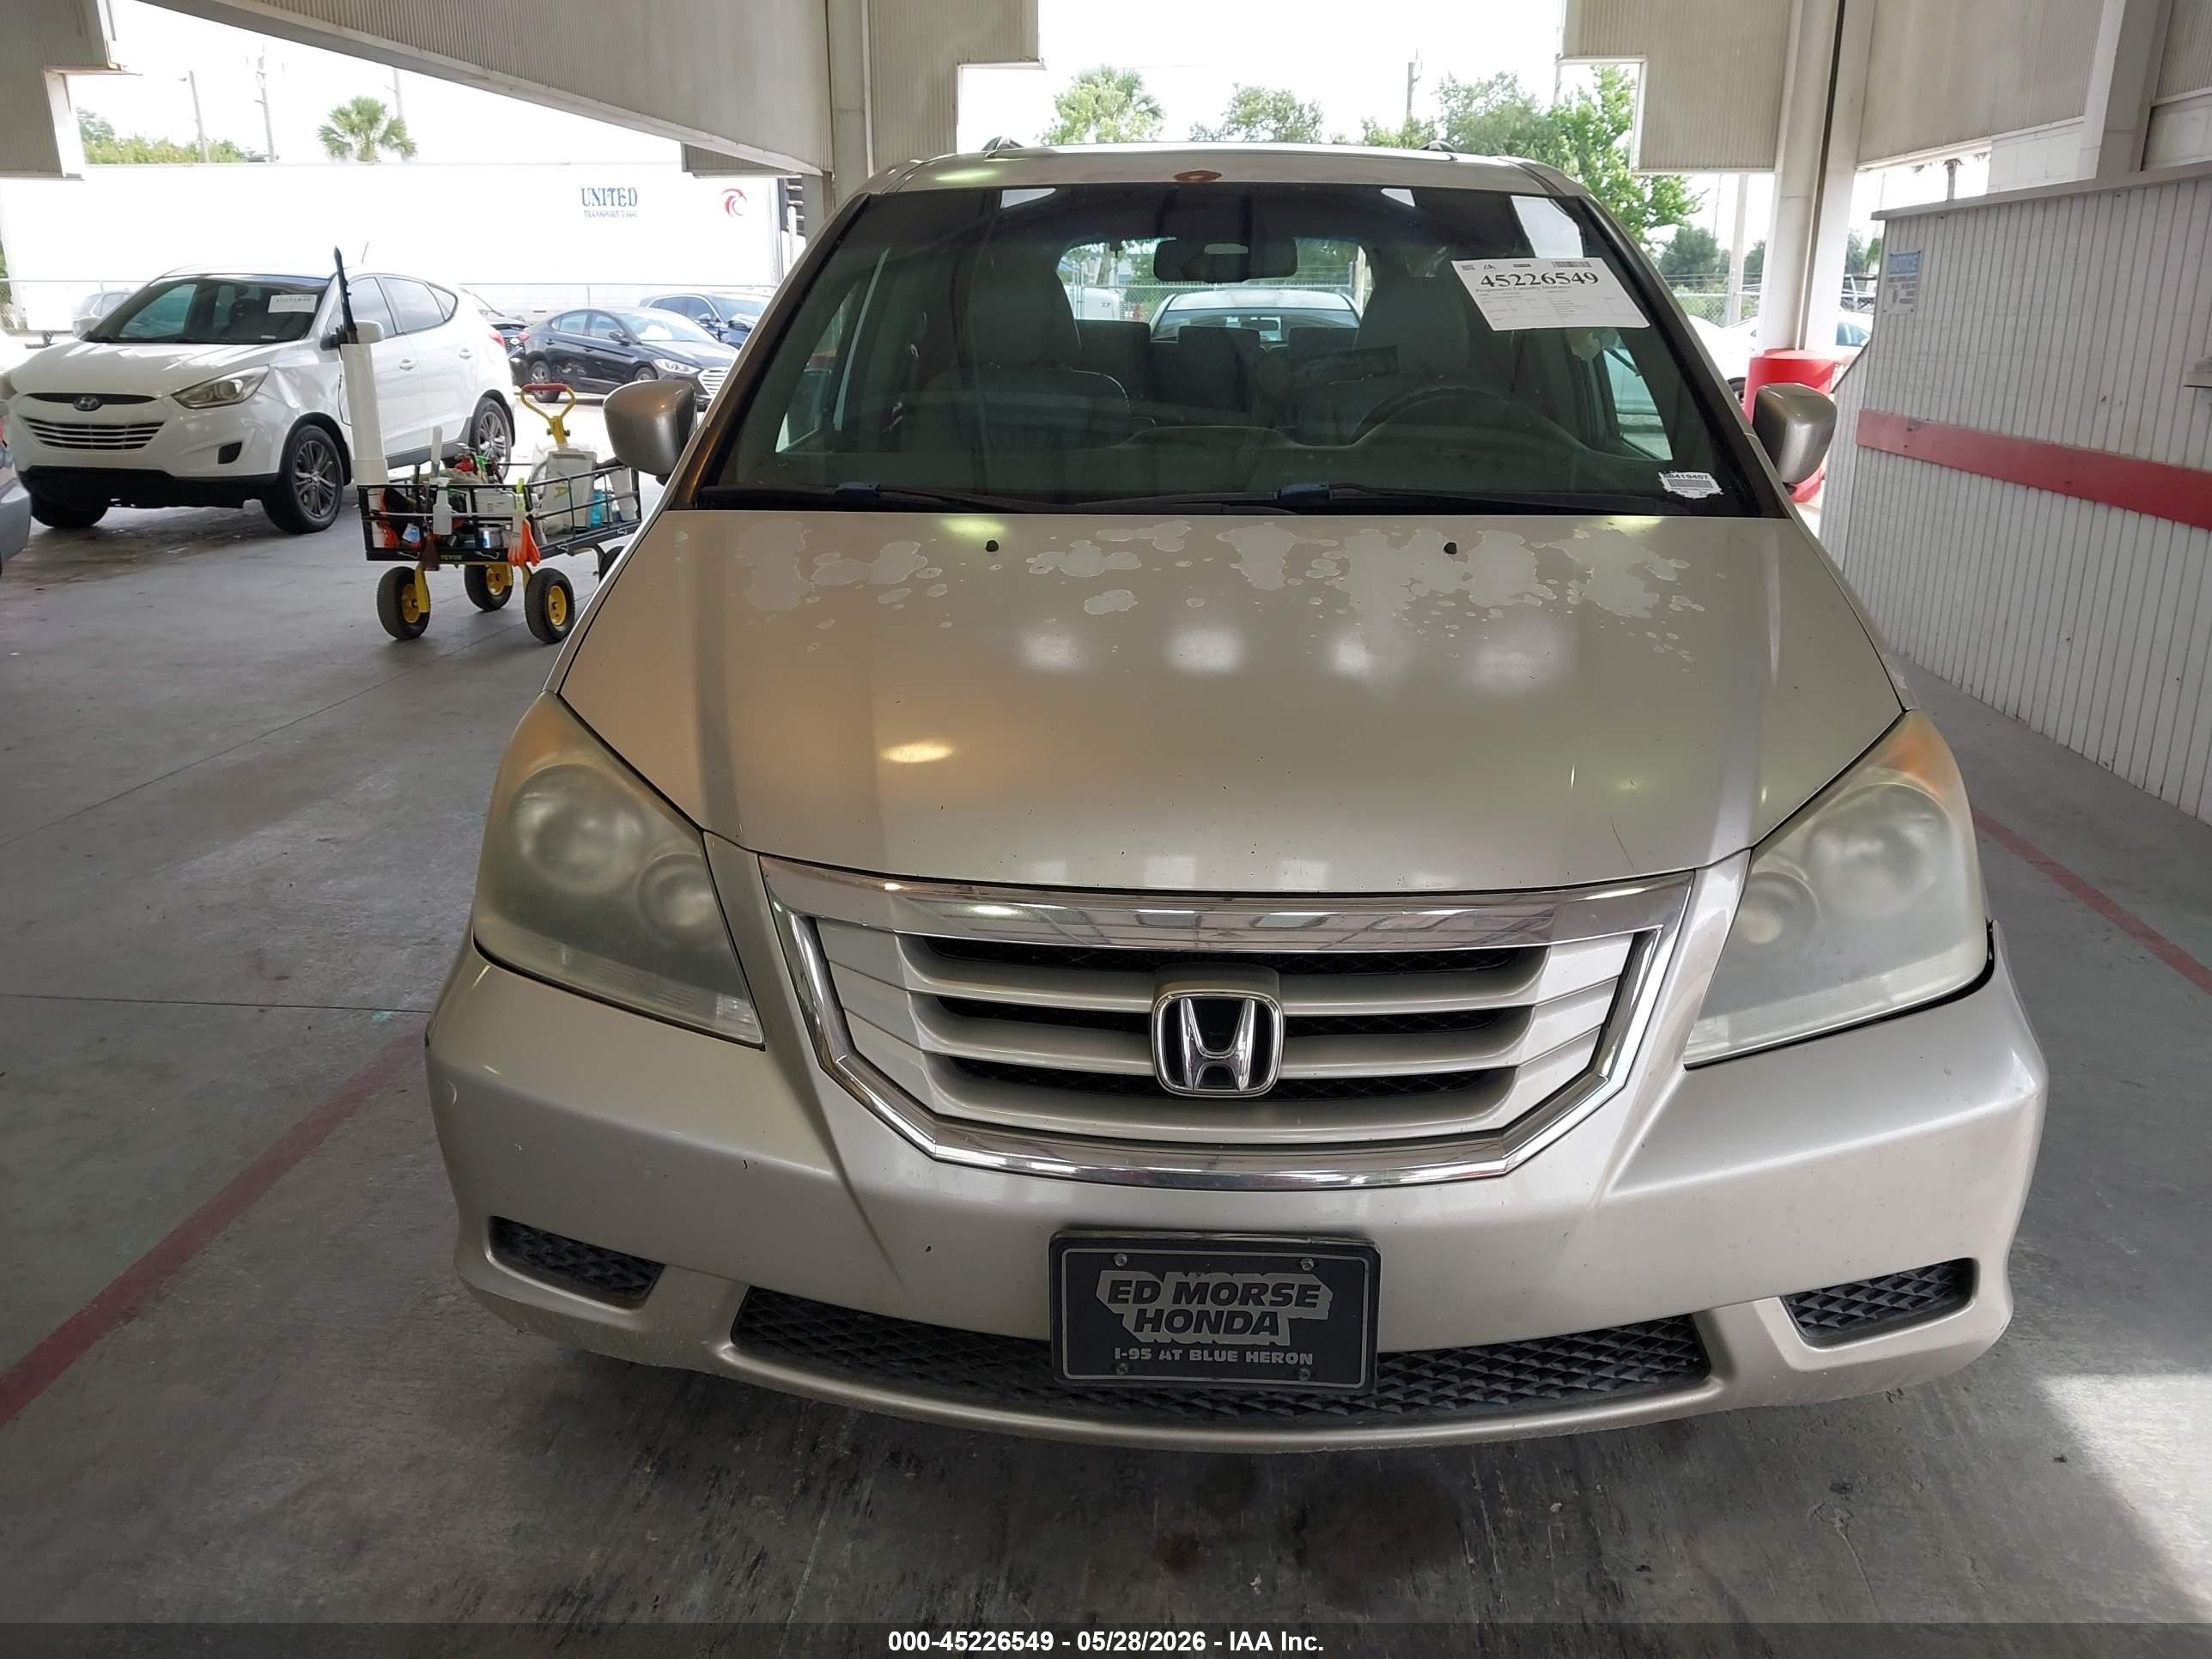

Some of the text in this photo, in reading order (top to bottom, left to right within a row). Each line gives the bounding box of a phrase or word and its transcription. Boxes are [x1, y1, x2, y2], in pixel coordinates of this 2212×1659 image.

[580, 187, 638, 207] UNITED
[1480, 272, 1598, 287] 45226549
[1106, 1279, 1322, 1308] ED MORSE
[1133, 1310, 1279, 1336] HONDA
[1115, 1347, 1313, 1366] I-95 AT BLUE HERON
